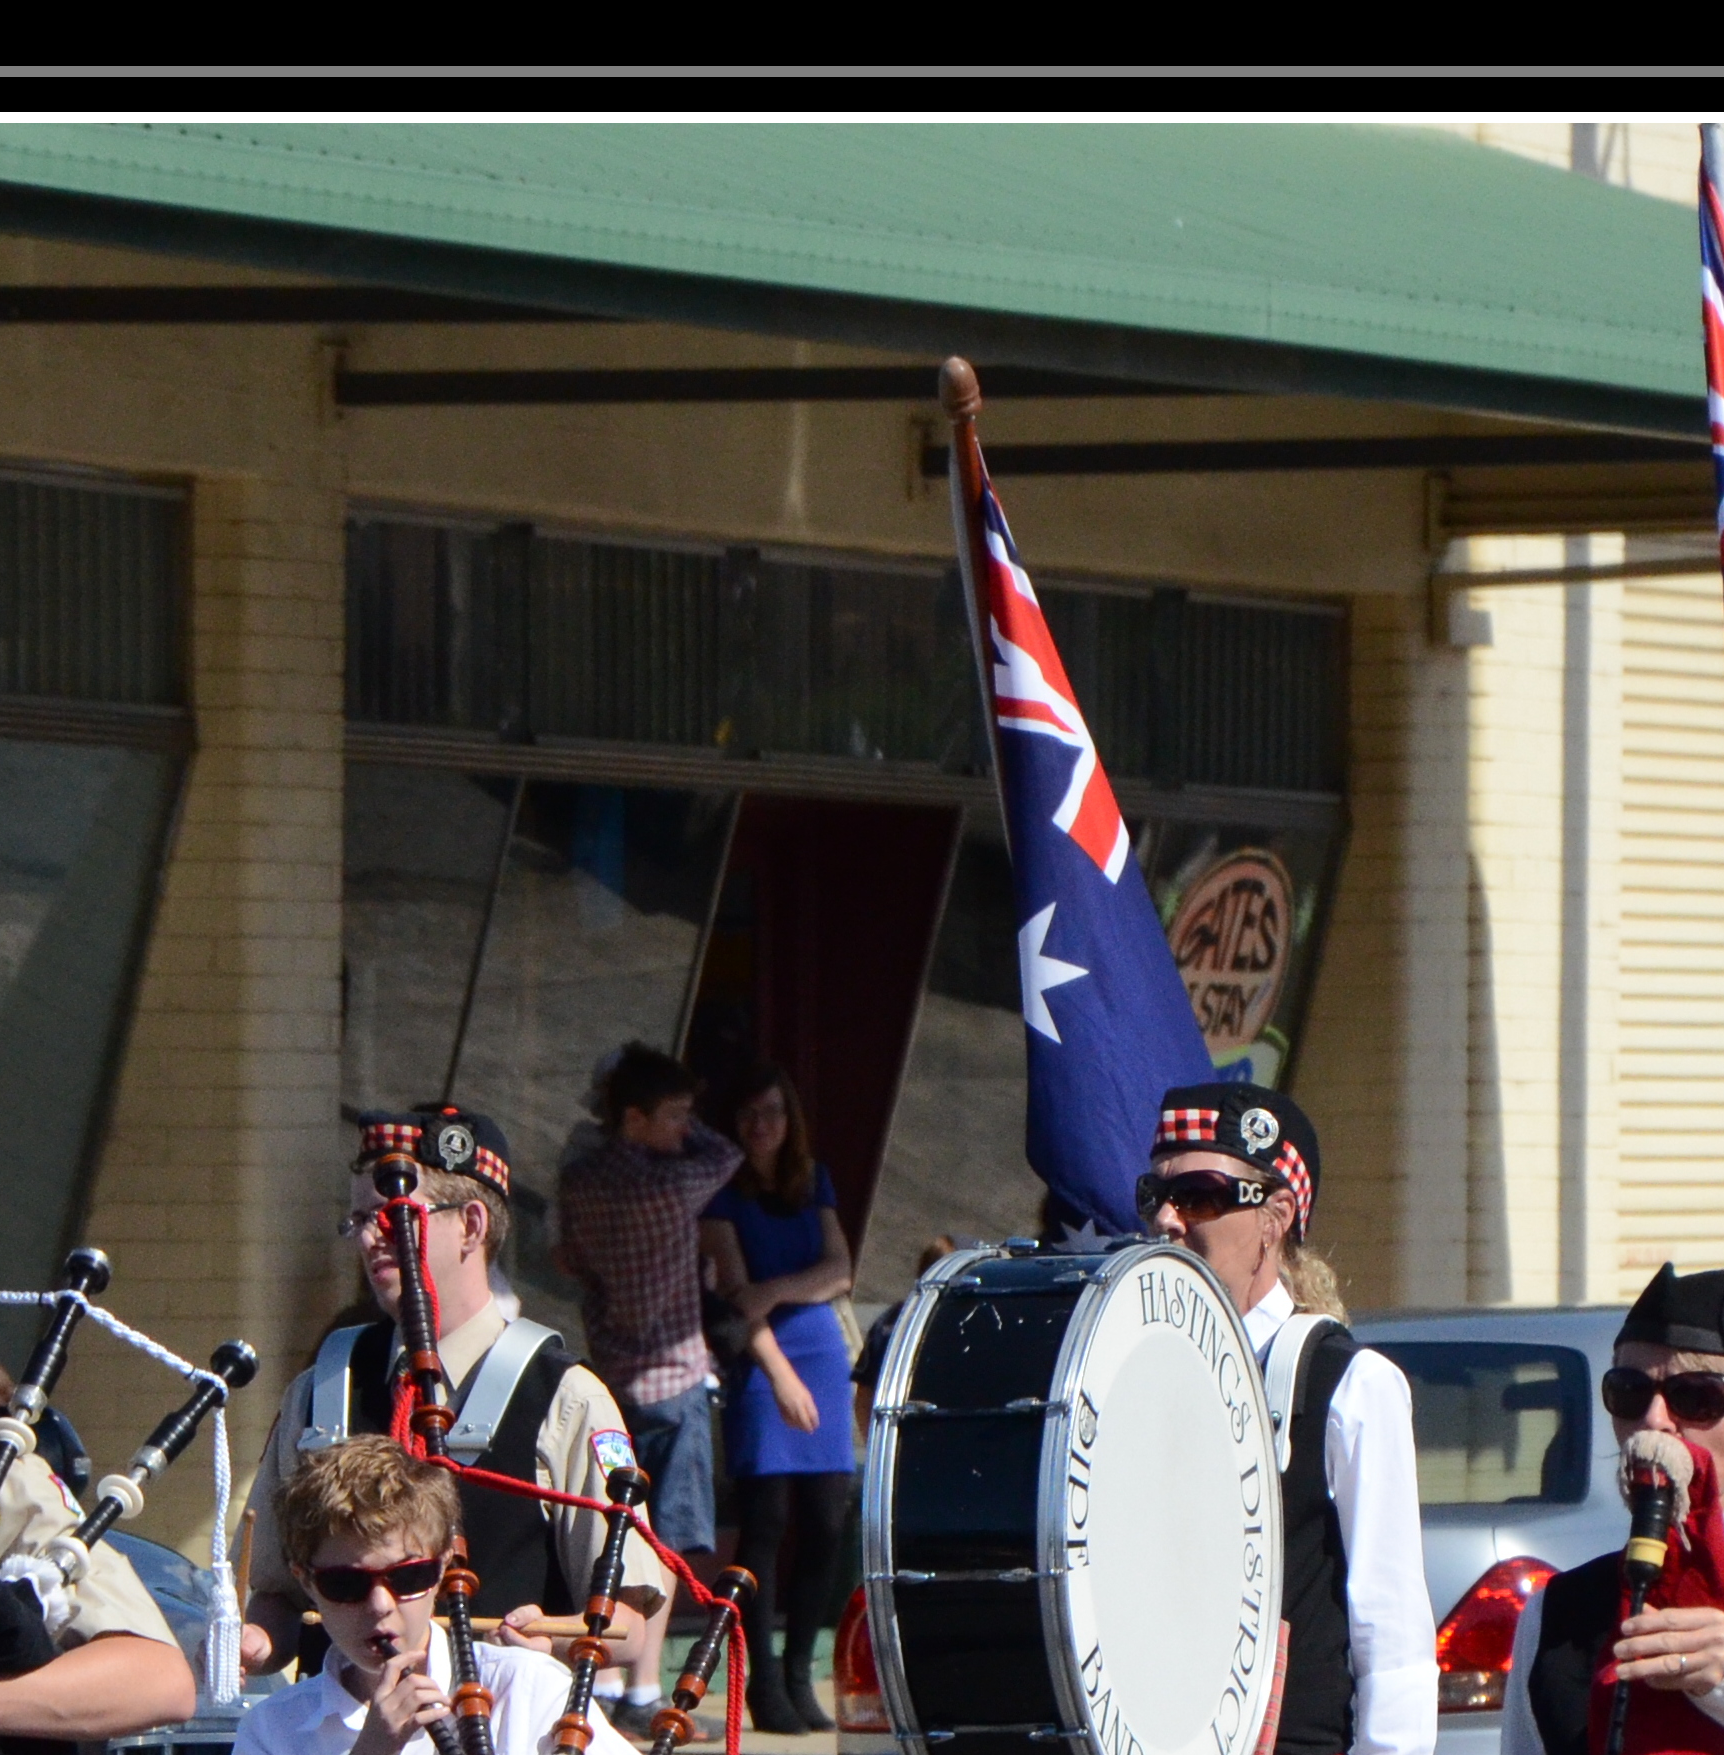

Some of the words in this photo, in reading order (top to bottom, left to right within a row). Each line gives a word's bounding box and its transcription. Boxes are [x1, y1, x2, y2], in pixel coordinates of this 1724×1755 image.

[1238, 1181, 1264, 1204] DG
[1138, 1270, 1252, 1444] HASTINGS
[1067, 1386, 1099, 1571] PIPE
